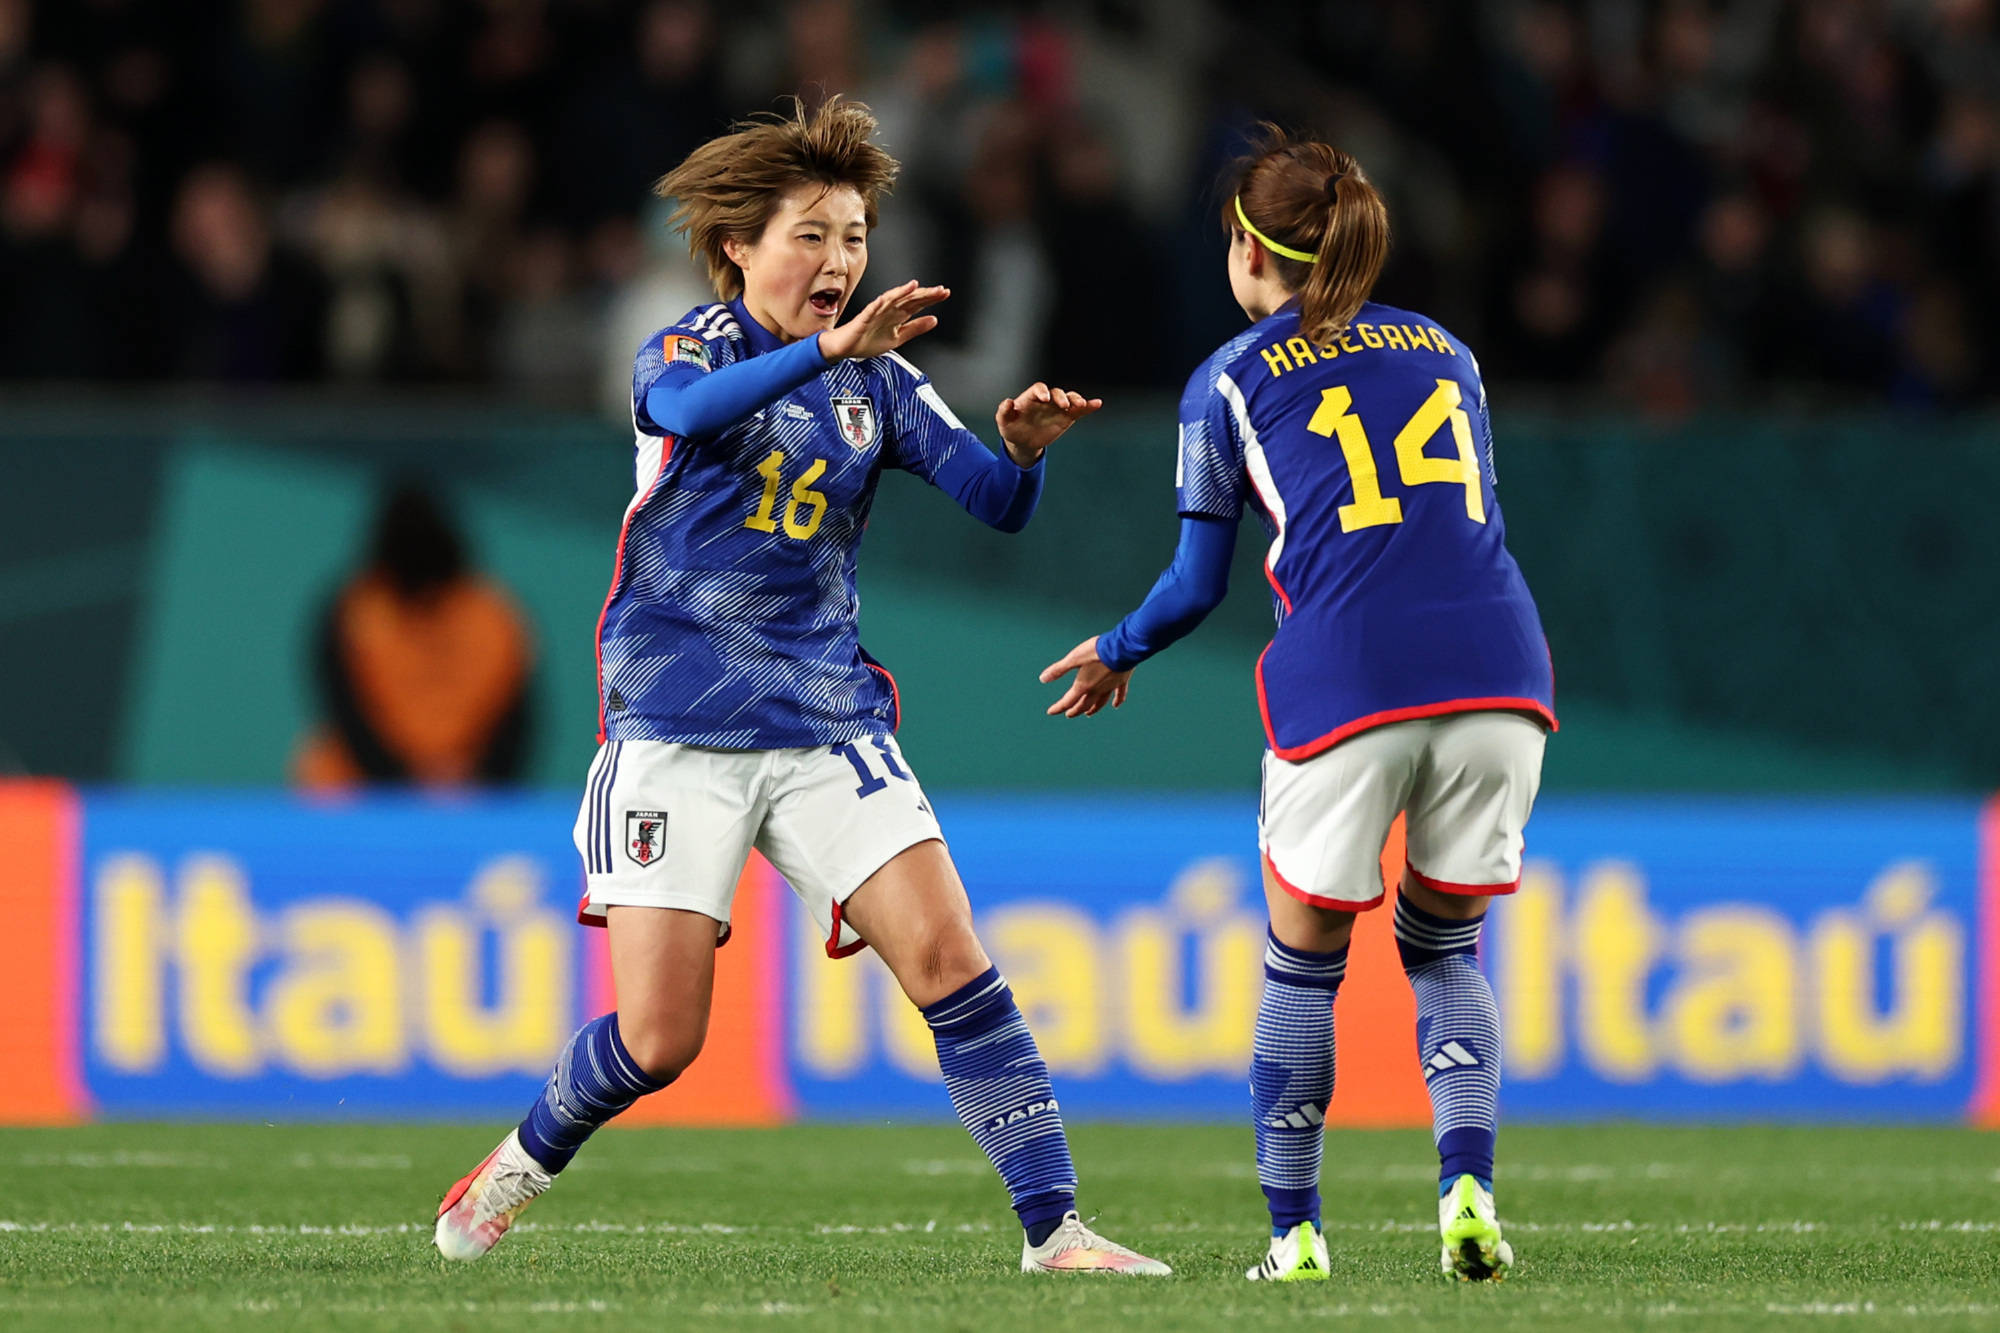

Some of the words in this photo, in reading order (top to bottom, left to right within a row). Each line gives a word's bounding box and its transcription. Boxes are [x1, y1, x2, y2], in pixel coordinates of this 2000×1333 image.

[744, 450, 828, 541] 16
[1306, 378, 1487, 534] 14
[635, 849, 654, 858] JFA
[98, 856, 571, 1076] Itaú
[803, 857, 1266, 1079] Iaú
[1505, 858, 1962, 1081] Itaú
